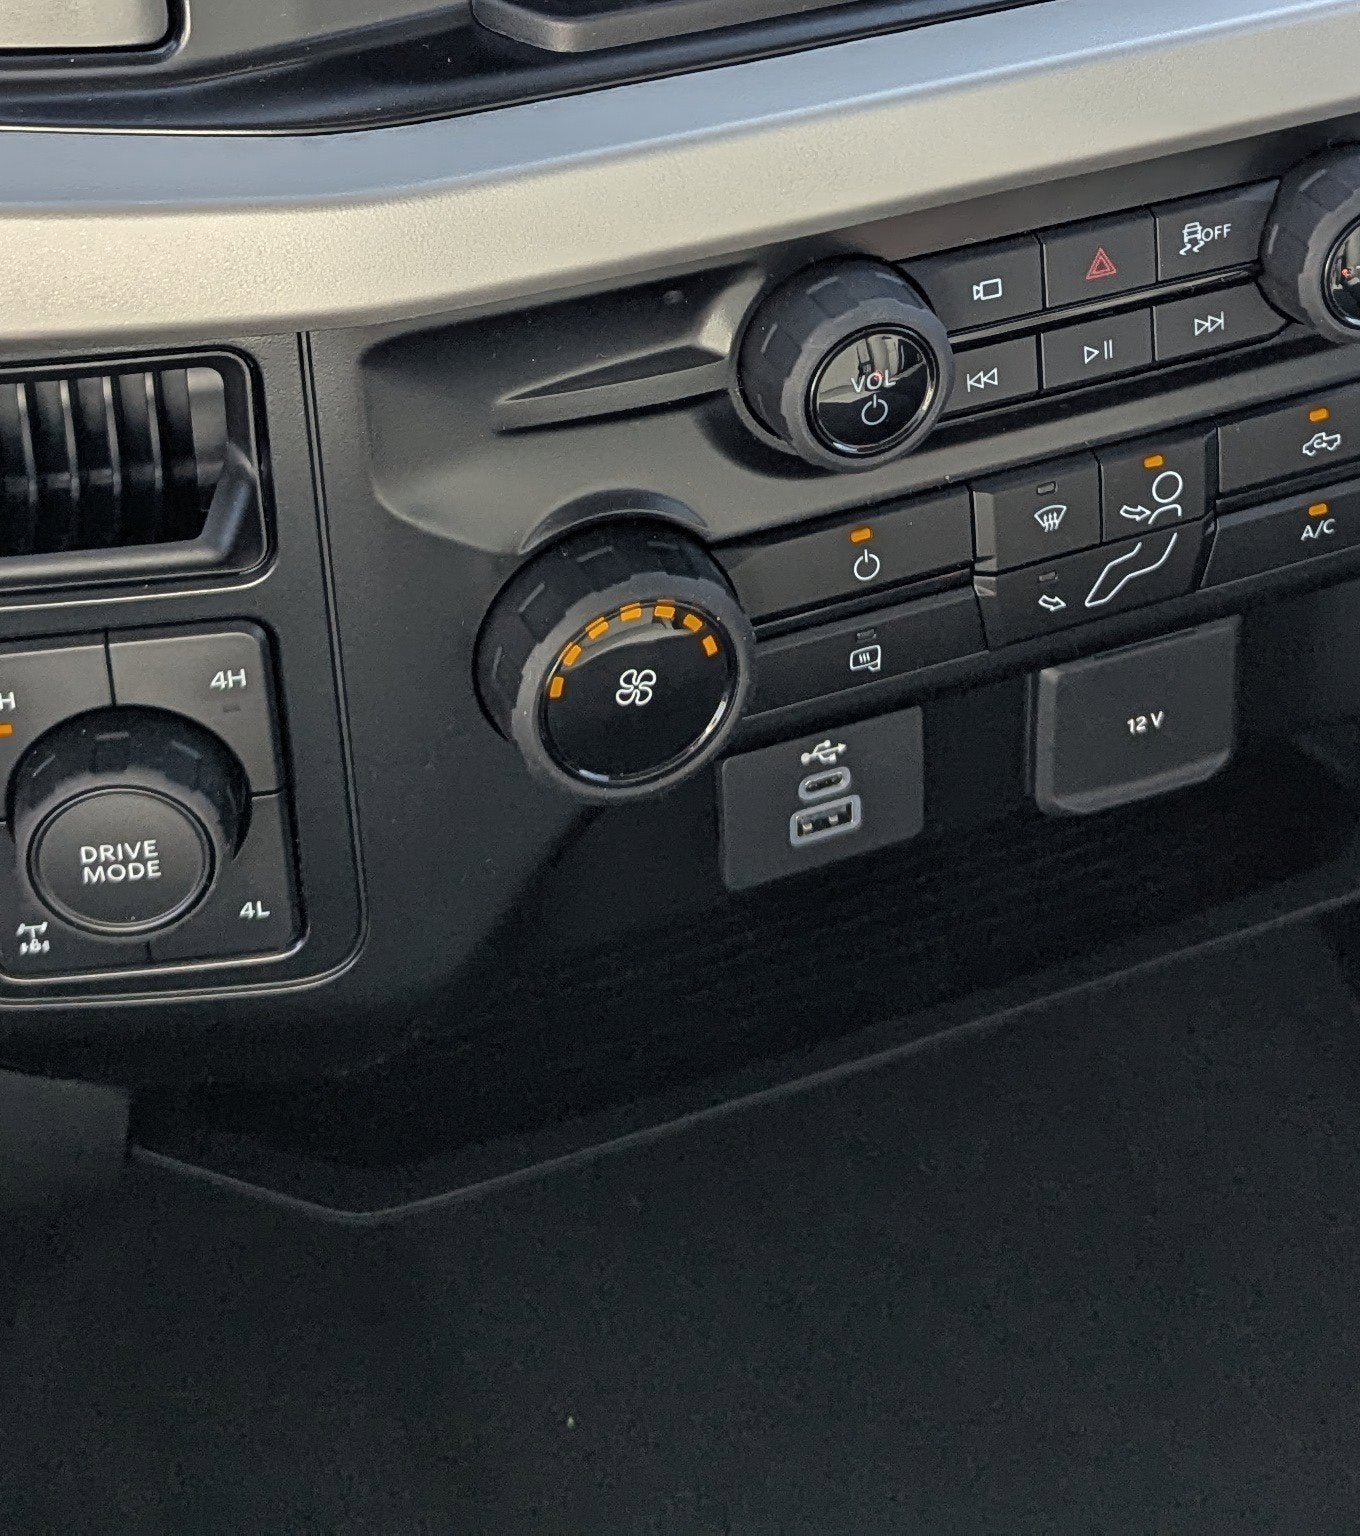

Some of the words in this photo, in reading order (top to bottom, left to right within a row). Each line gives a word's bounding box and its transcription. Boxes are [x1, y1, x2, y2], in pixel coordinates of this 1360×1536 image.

[1202, 222, 1232, 243] OFF
[850, 368, 897, 393] VOL
[1300, 517, 1337, 541] A/C
[208, 667, 248, 691] 4H
[79, 838, 160, 864] DRIVE
[82, 860, 163, 886] MODE
[239, 899, 271, 921] 4L
